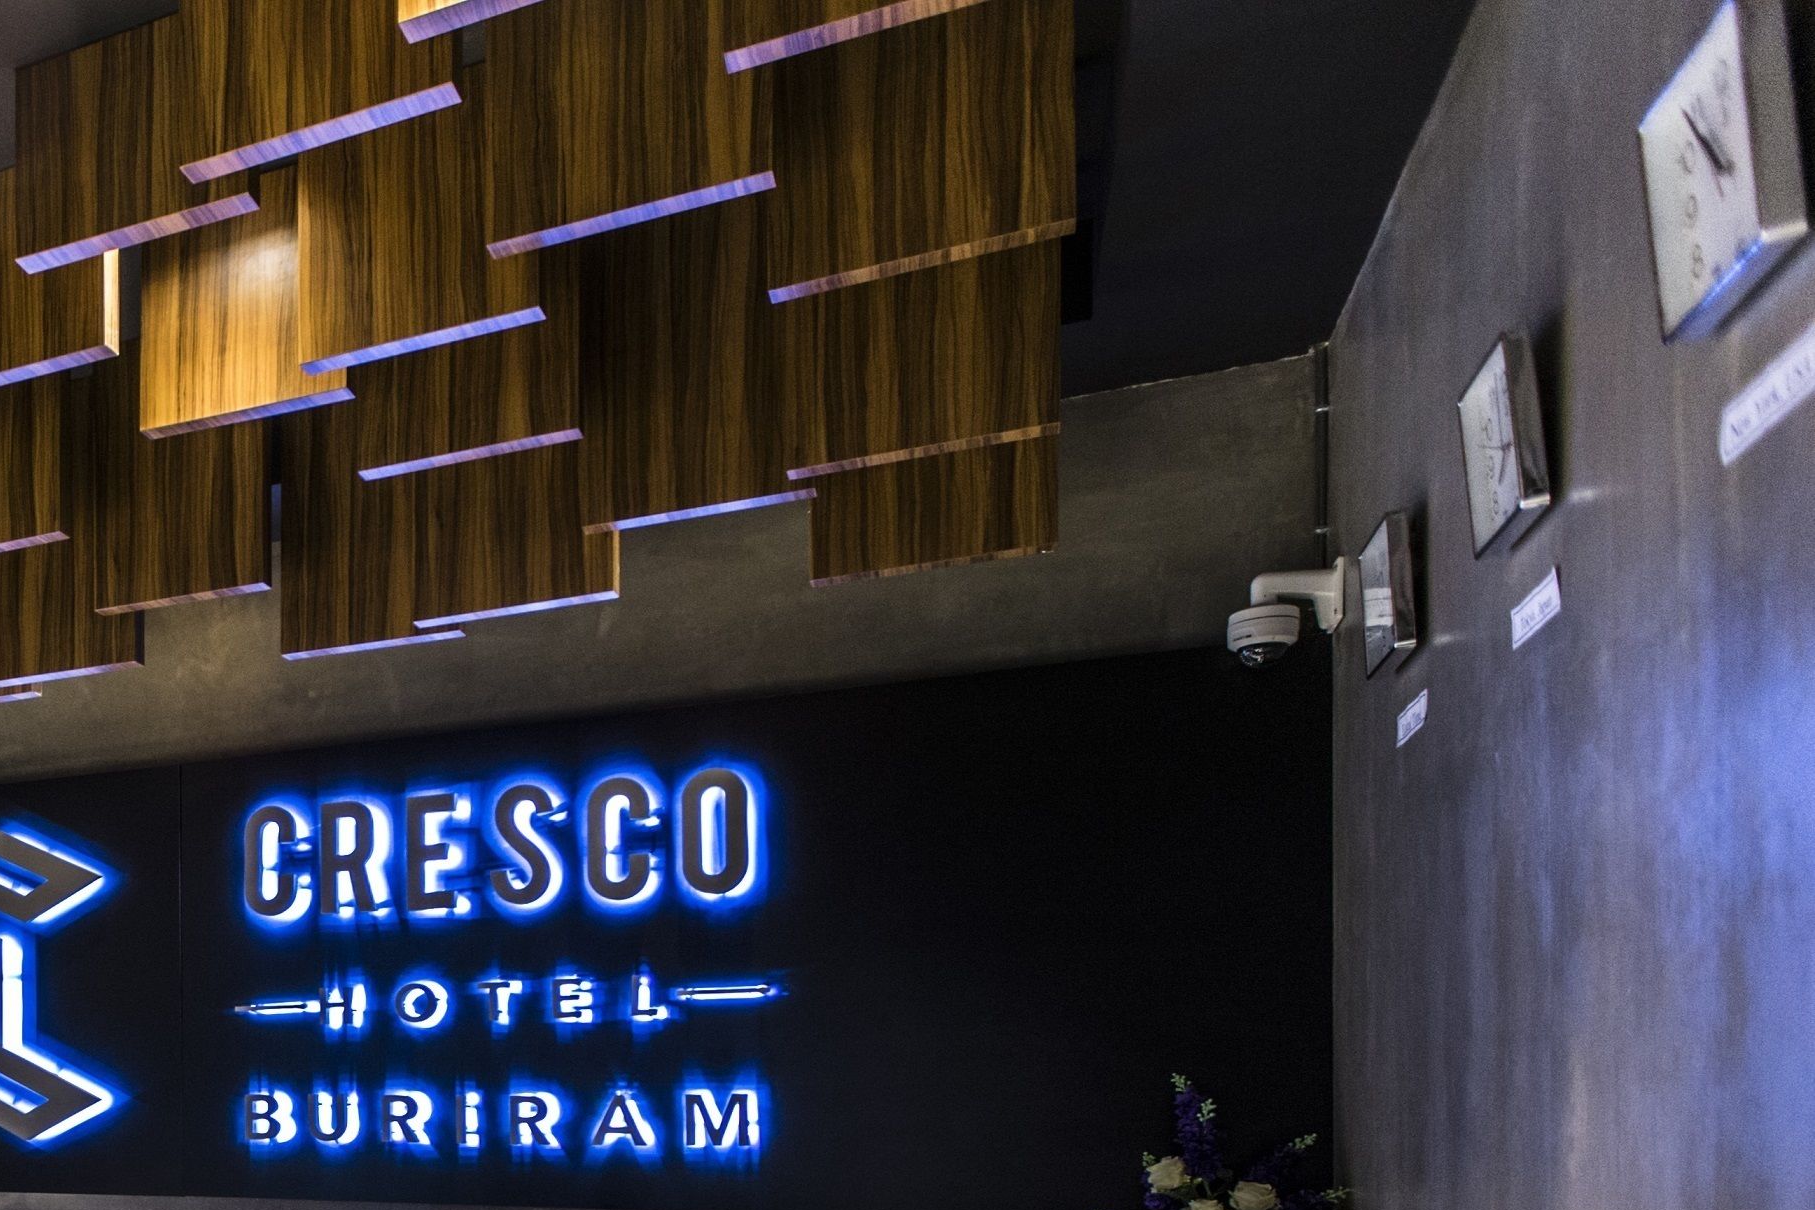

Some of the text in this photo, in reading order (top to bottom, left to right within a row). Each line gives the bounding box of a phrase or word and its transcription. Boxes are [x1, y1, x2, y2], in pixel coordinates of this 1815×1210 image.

[242, 766, 756, 920] CRESCO
[318, 972, 670, 1030] HOTEL
[242, 1088, 759, 1148] BURIRAM
